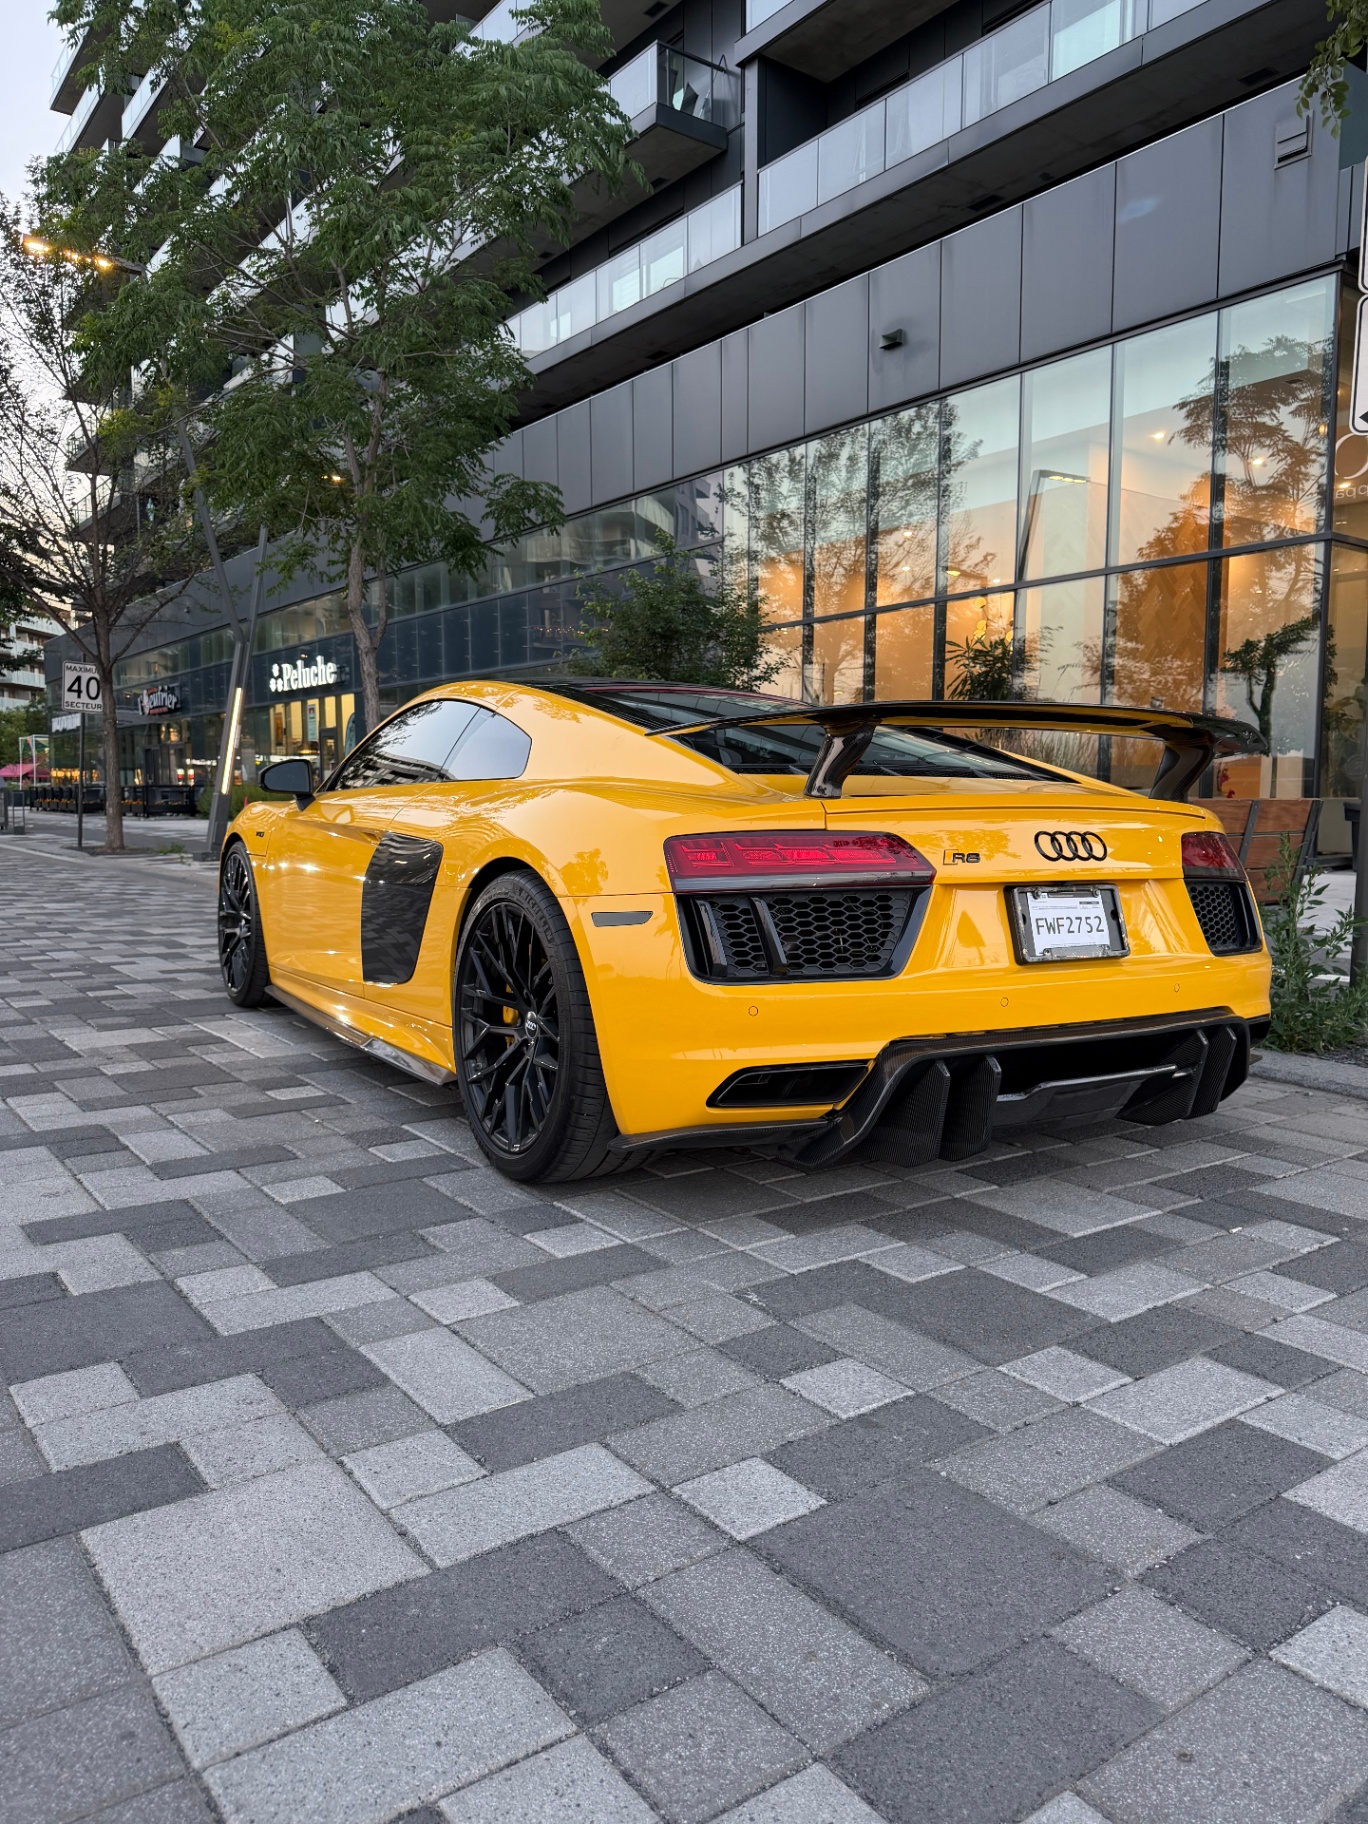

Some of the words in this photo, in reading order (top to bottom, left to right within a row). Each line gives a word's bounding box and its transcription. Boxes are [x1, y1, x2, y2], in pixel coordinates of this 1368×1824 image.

[66, 665, 98, 674] MAXIMU
[281, 655, 338, 691] Peluche
[67, 675, 101, 701] 40
[65, 701, 103, 710] SECTEUR
[952, 853, 981, 864] R8
[1035, 915, 1105, 936] FWF2752
